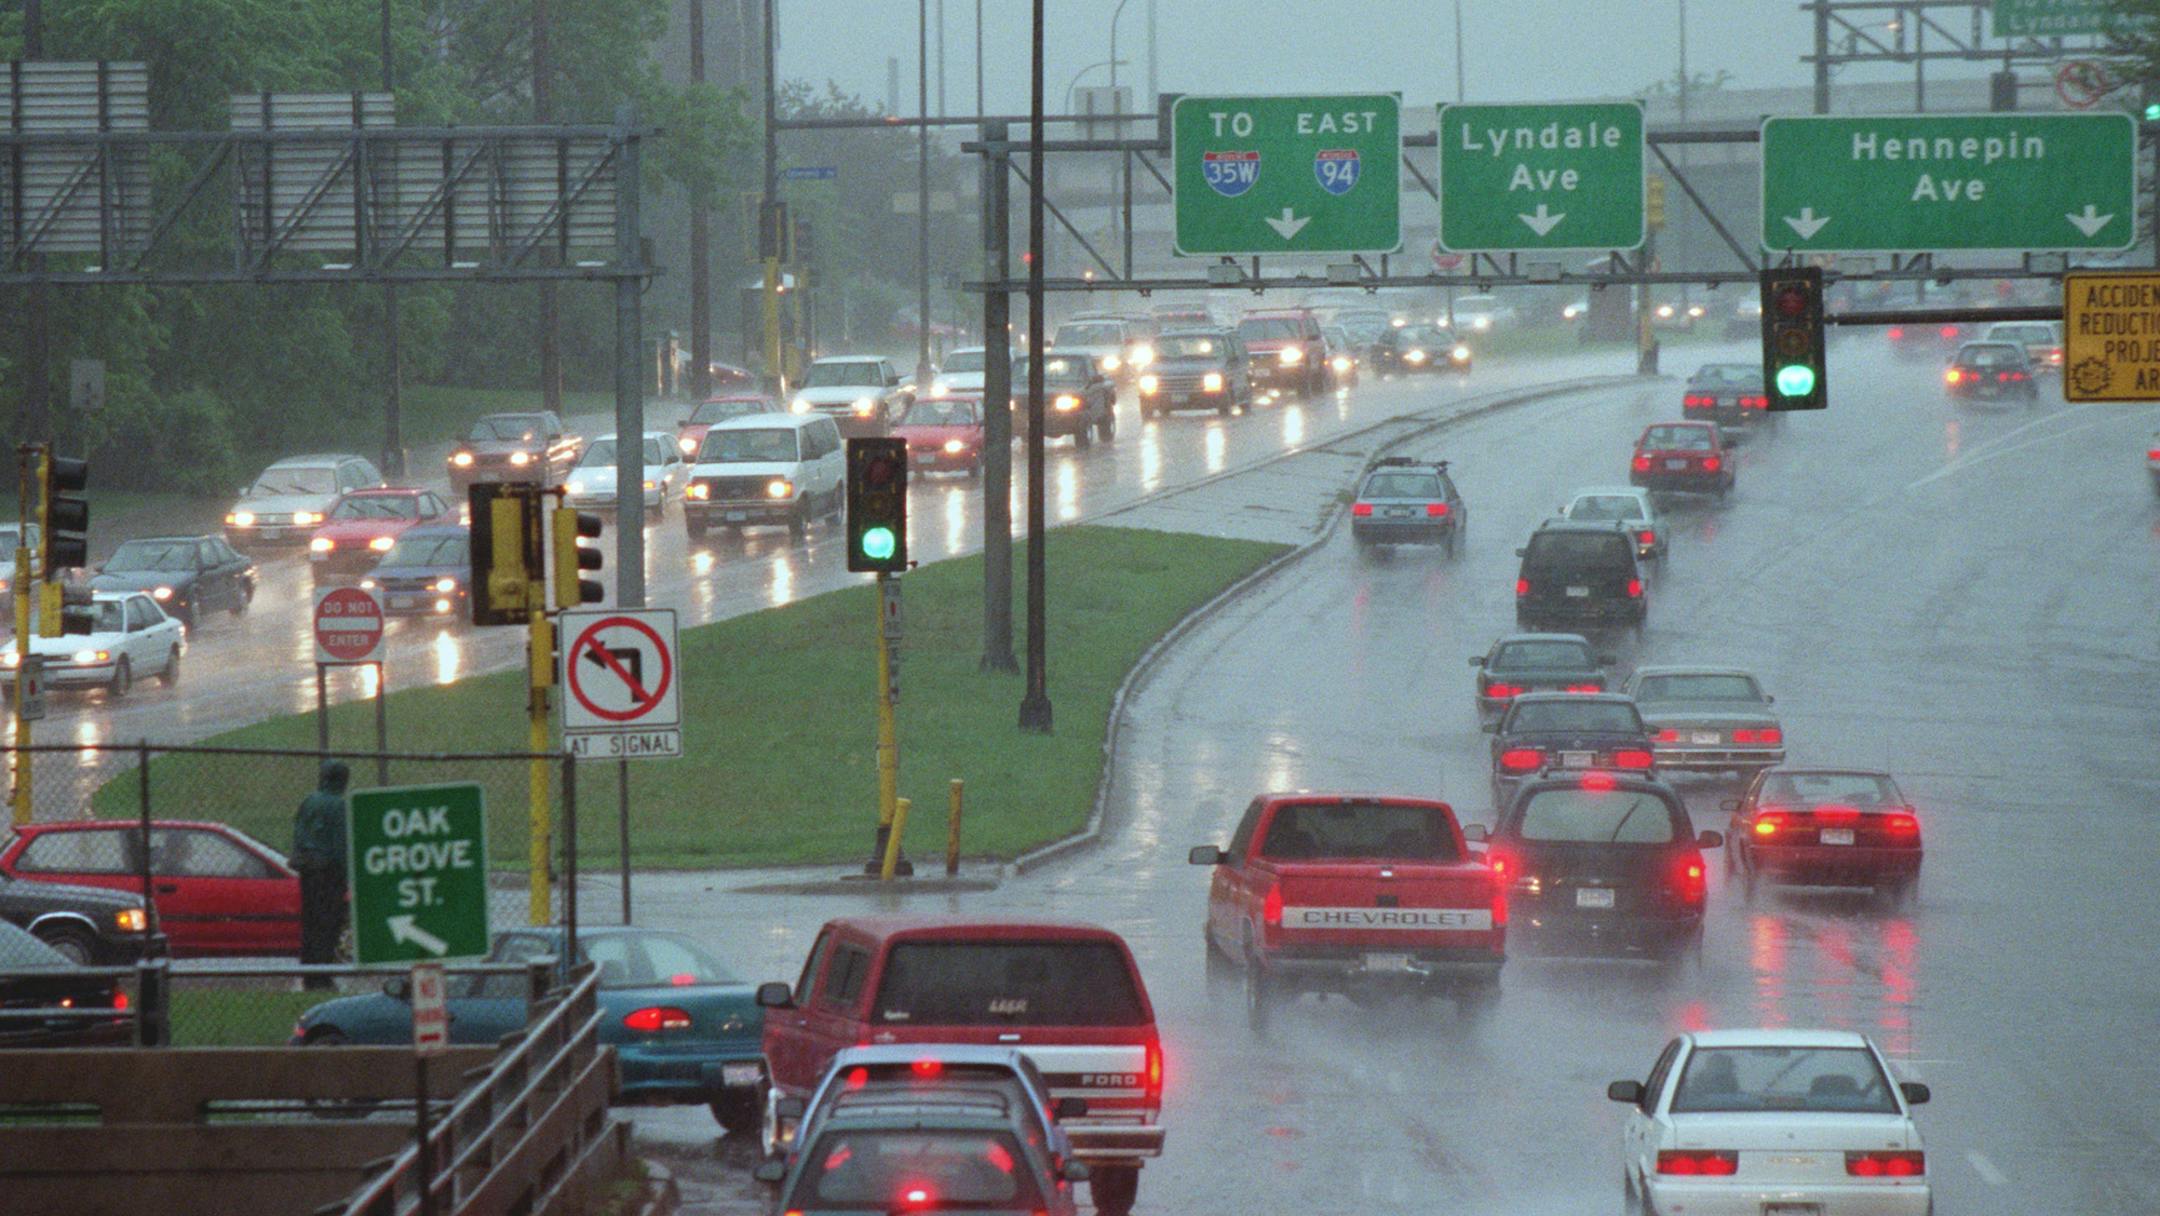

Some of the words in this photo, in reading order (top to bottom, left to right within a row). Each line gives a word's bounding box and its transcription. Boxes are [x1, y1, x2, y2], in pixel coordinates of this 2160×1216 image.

[1209, 111, 1253, 137] TO
[1297, 111, 1376, 134] EAST
[1461, 121, 1622, 157] Lyndale
[1852, 131, 2045, 165] Hennepin
[1208, 162, 1257, 184] 35W
[1322, 161, 1353, 186] 94
[1508, 163, 1579, 191] Ave
[1910, 174, 1986, 201] Ave
[324, 602, 342, 614] DO
[348, 601, 372, 614] NOT
[328, 634, 370, 647] ENTER
[571, 737, 589, 755] AT
[610, 734, 674, 754] SIGNAL
[382, 805, 450, 838] OAK
[364, 840, 474, 875] GROVE
[398, 876, 444, 907] ST.
[1303, 911, 1472, 926] CHEVROLET
[1081, 1074, 1138, 1086] FORD
